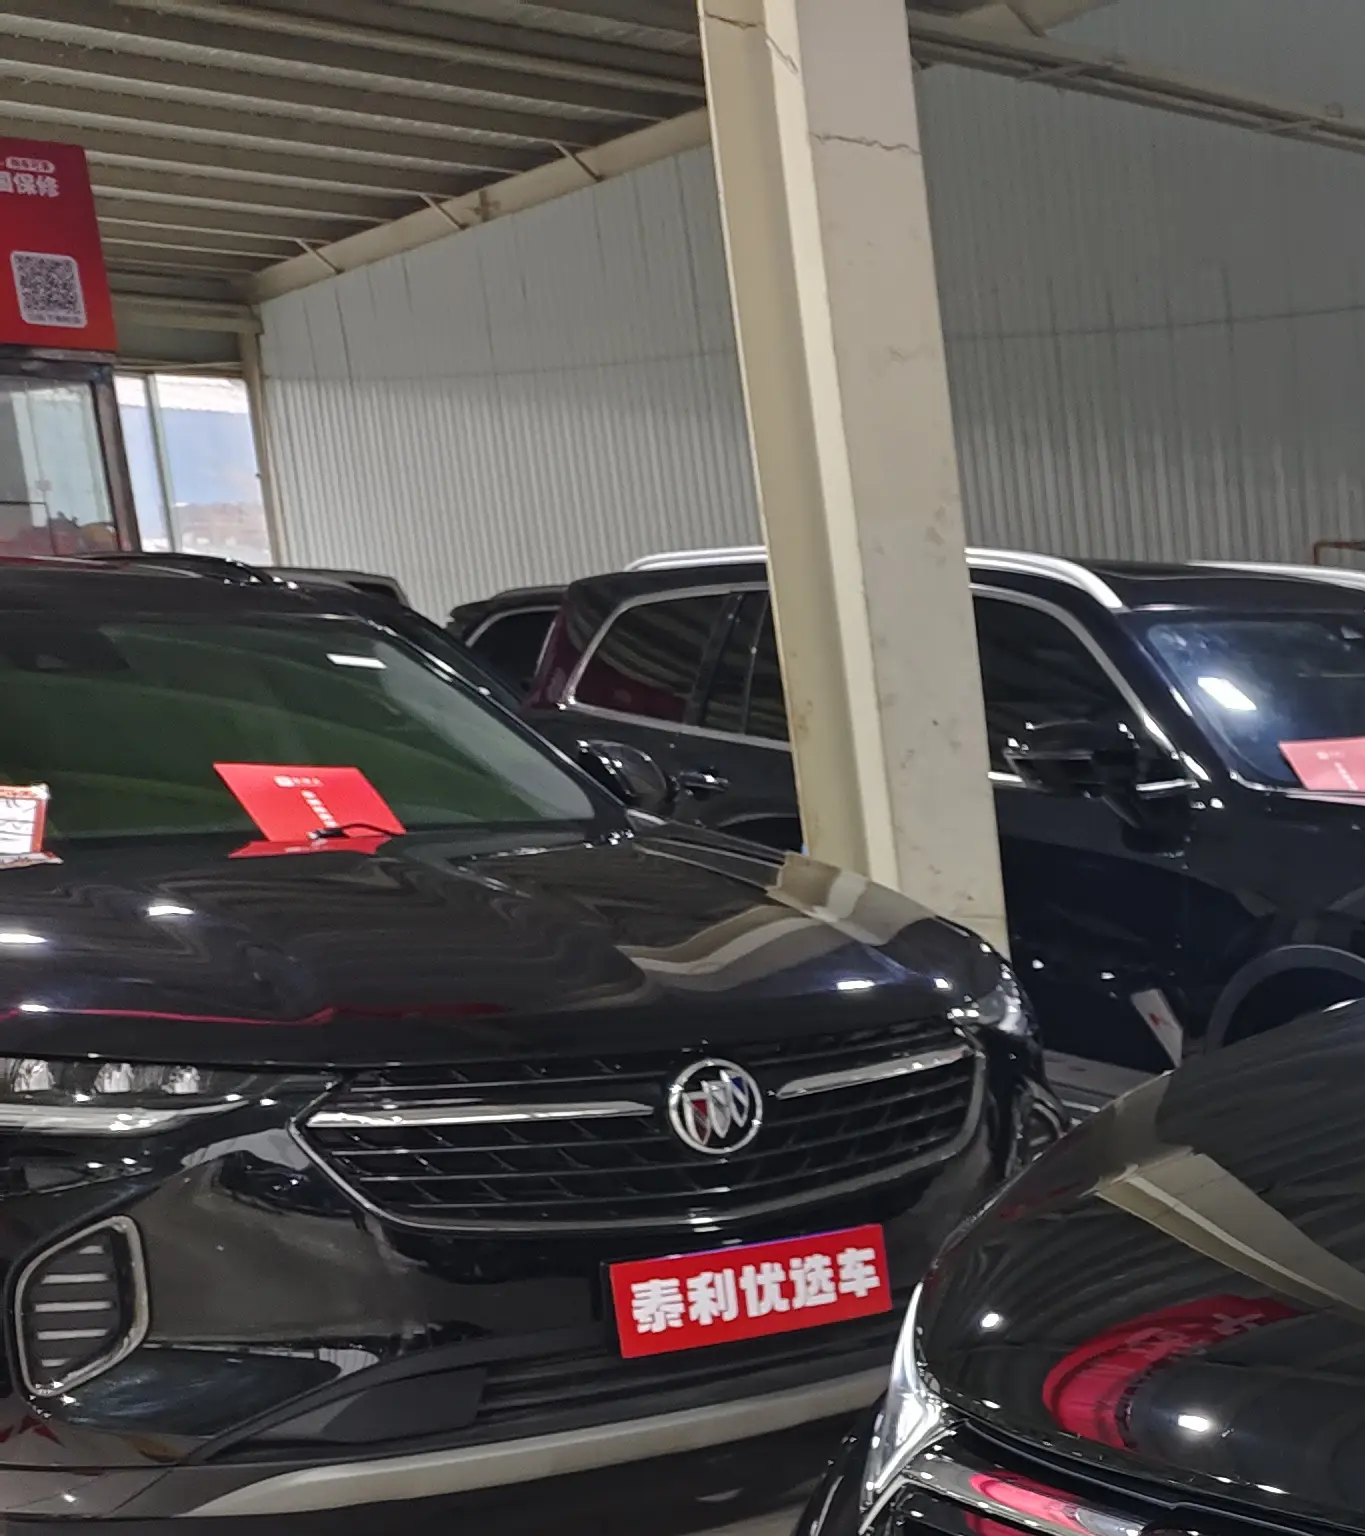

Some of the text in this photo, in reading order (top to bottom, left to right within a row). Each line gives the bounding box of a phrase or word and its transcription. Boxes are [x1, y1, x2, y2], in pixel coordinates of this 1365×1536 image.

[631, 1247, 881, 1334] 泰利优选车
